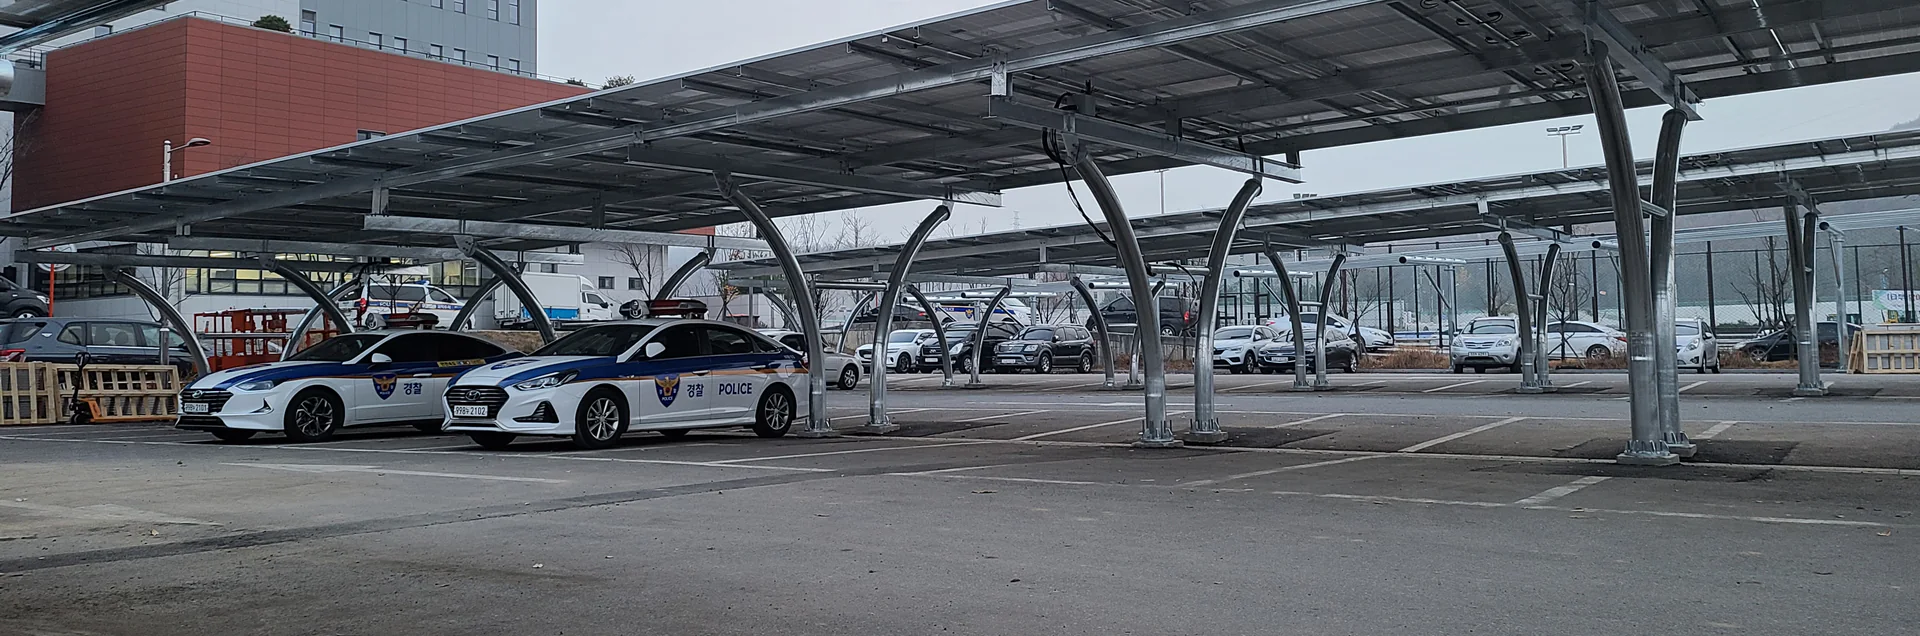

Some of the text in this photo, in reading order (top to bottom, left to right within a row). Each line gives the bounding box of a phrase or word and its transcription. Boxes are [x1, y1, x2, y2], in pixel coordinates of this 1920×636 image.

[403, 382, 423, 395] 경찰
[687, 383, 704, 398] 경찰
[718, 382, 752, 395] POLICE
